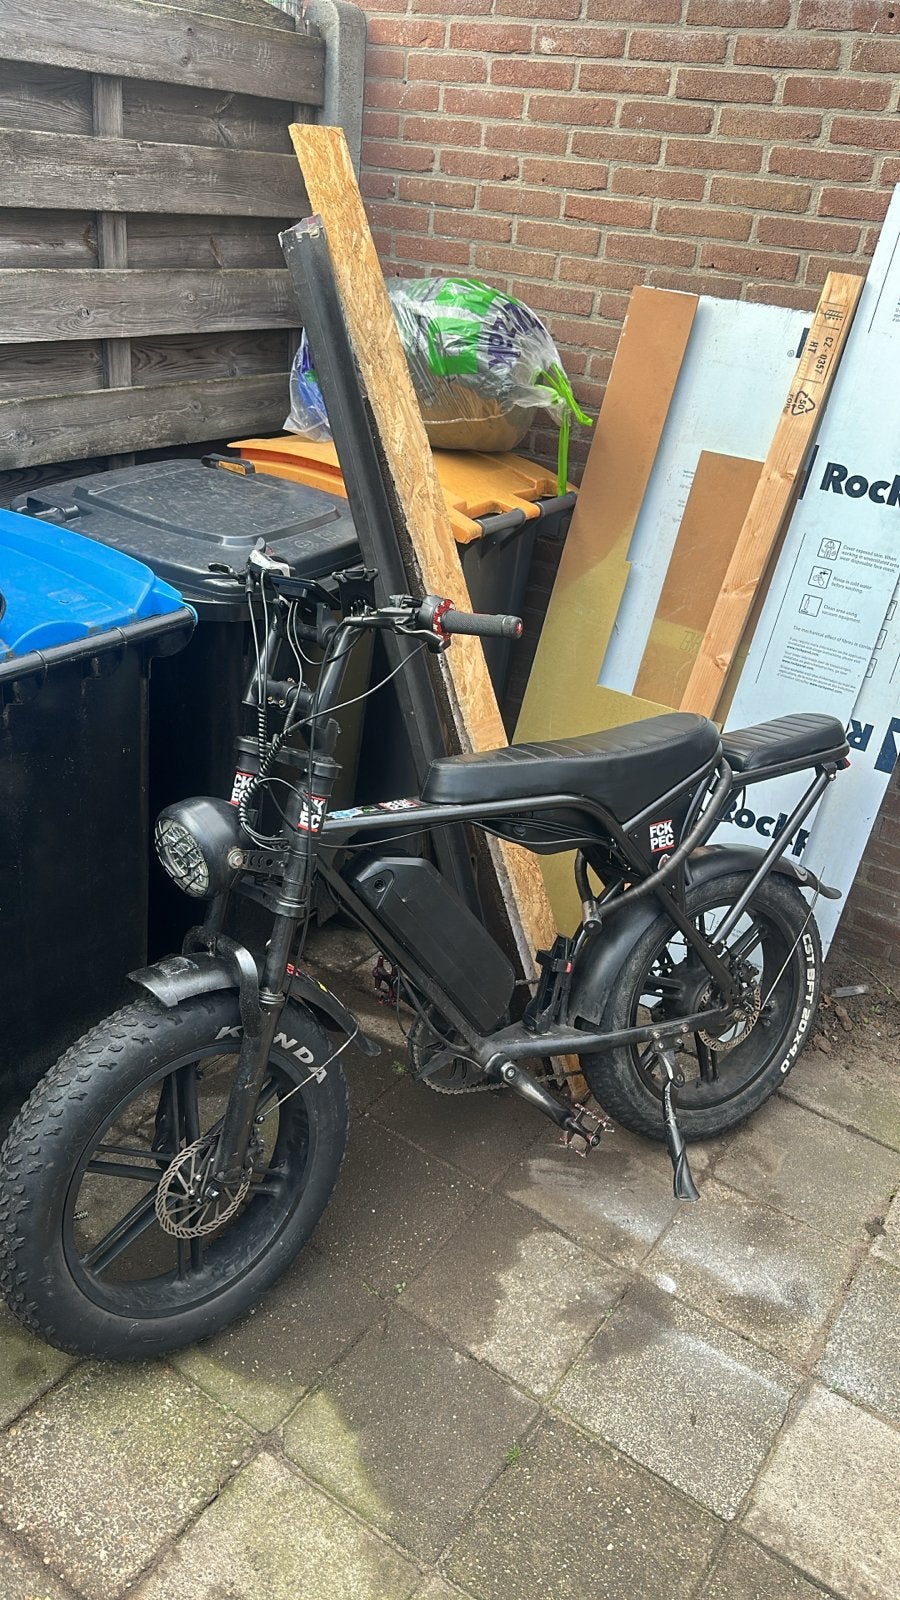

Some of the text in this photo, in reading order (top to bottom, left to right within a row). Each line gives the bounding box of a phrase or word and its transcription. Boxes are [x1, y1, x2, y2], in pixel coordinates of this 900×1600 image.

[808, 341, 819, 354] HT
[798, 399, 807, 410] 50
[650, 821, 673, 838] FCK
[650, 833, 674, 851] PEC
[802, 933, 815, 964] CST
[805, 968, 815, 1004] BFT
[214, 1025, 328, 1084] KNDA
